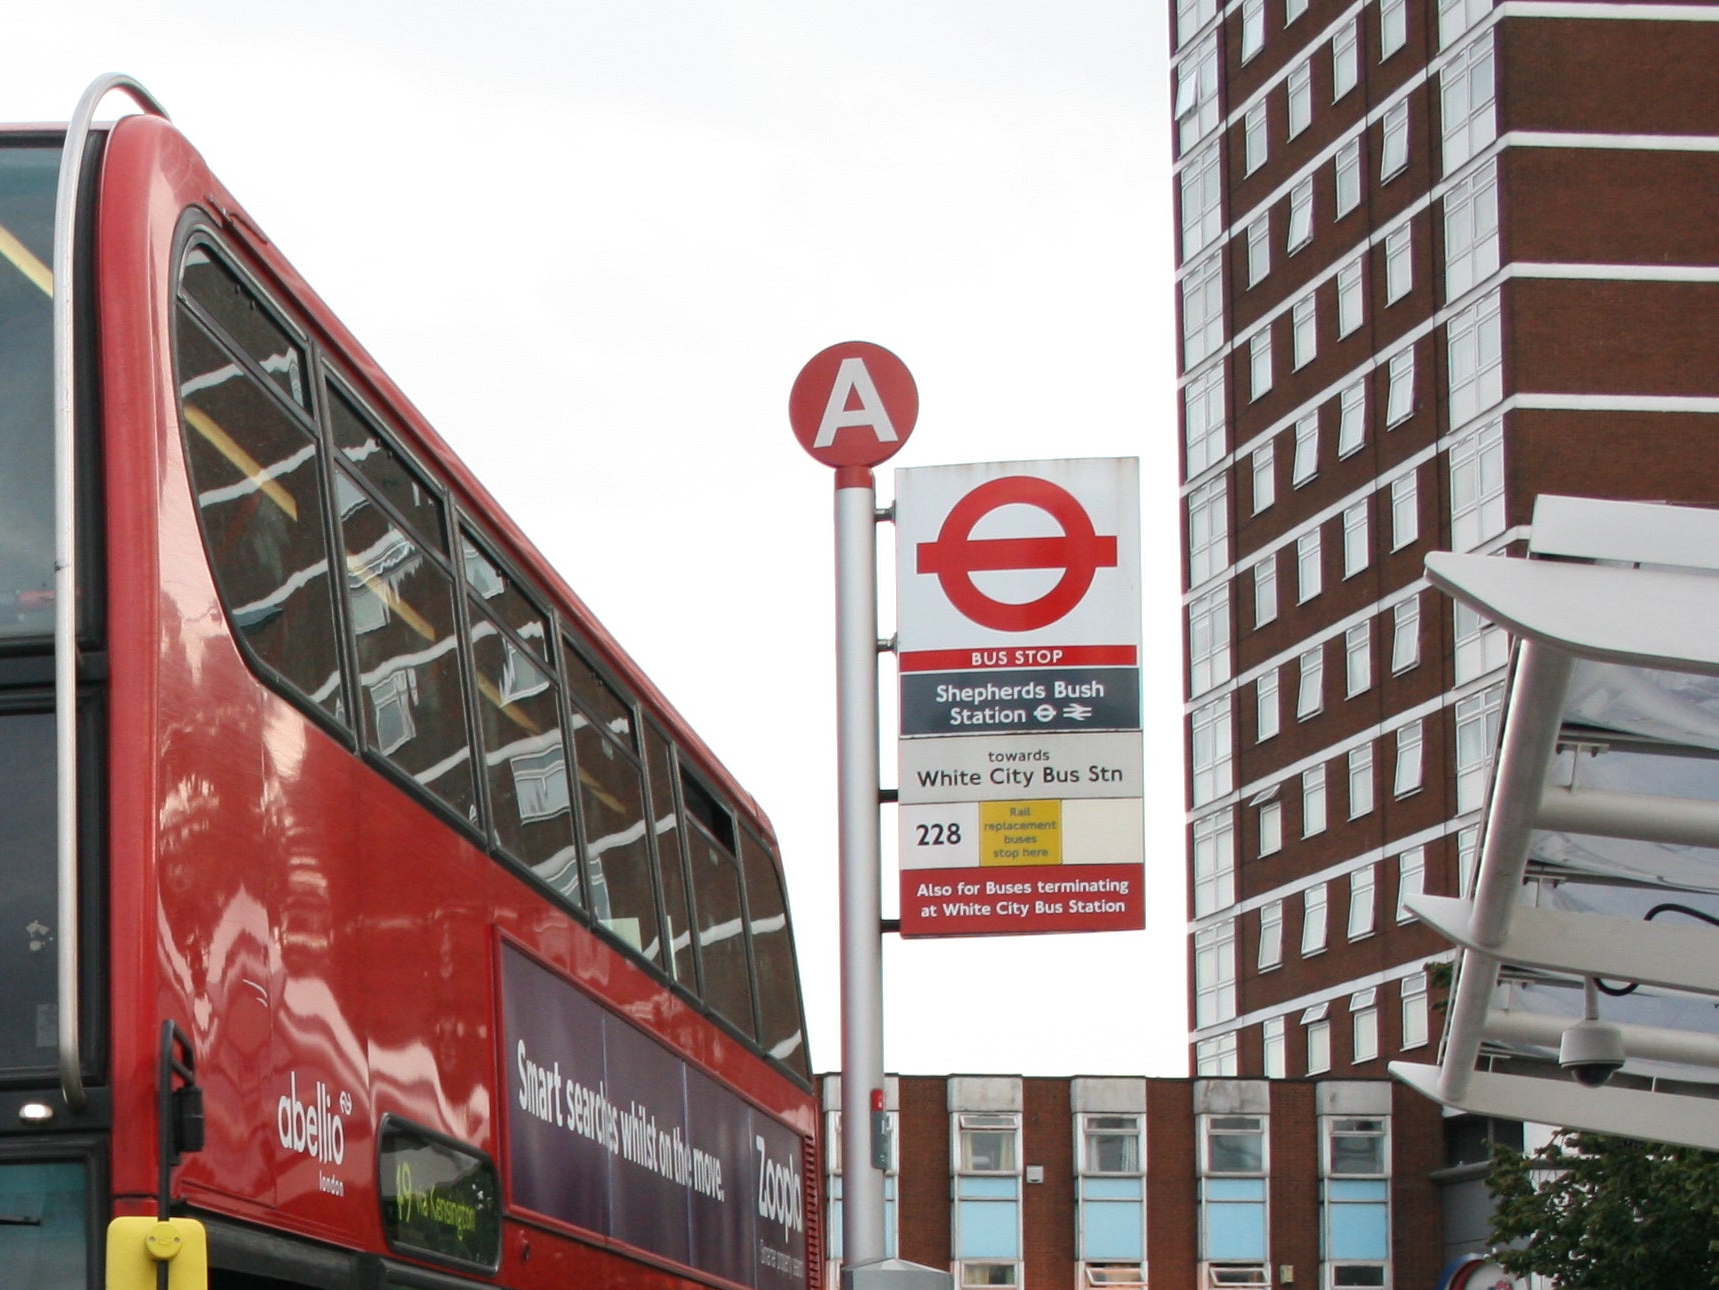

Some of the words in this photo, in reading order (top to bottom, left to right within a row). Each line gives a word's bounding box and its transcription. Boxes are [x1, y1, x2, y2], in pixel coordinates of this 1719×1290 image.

[813, 357, 899, 449] A
[971, 652, 1008, 666] BUS
[1014, 649, 1064, 664] STOP
[935, 682, 1046, 705] Shepherds
[1053, 680, 1105, 699] Bush
[949, 706, 1026, 726] Station
[987, 749, 1050, 763] towards
[917, 769, 982, 788] White
[989, 767, 1034, 789] City
[1042, 766, 1080, 784] Bus
[1088, 765, 1123, 783] Stn
[1009, 807, 1031, 817] Rail
[915, 822, 962, 847] 228
[984, 819, 1057, 832] replacement
[1003, 833, 1038, 845] buses
[993, 847, 1019, 860] stop
[1022, 846, 1049, 858] here
[916, 883, 952, 898] Also
[957, 881, 980, 895] for
[985, 881, 1032, 895] Buses
[1037, 878, 1130, 895] terminating
[920, 904, 937, 918] at
[942, 902, 991, 917] White
[996, 900, 1029, 918] City
[1034, 900, 1063, 914] Bus
[1068, 899, 1126, 914] Station
[278, 1070, 344, 1166] abellio
[517, 1039, 563, 1128] Smart
[565, 1078, 619, 1155] searches
[620, 1100, 658, 1173] whilst
[658, 1130, 673, 1180] on
[672, 1126, 692, 1187] the
[693, 1148, 724, 1202] move.
[319, 1169, 344, 1197] london
[395, 1161, 412, 1223] 49
[755, 1134, 803, 1244] Zoopla
